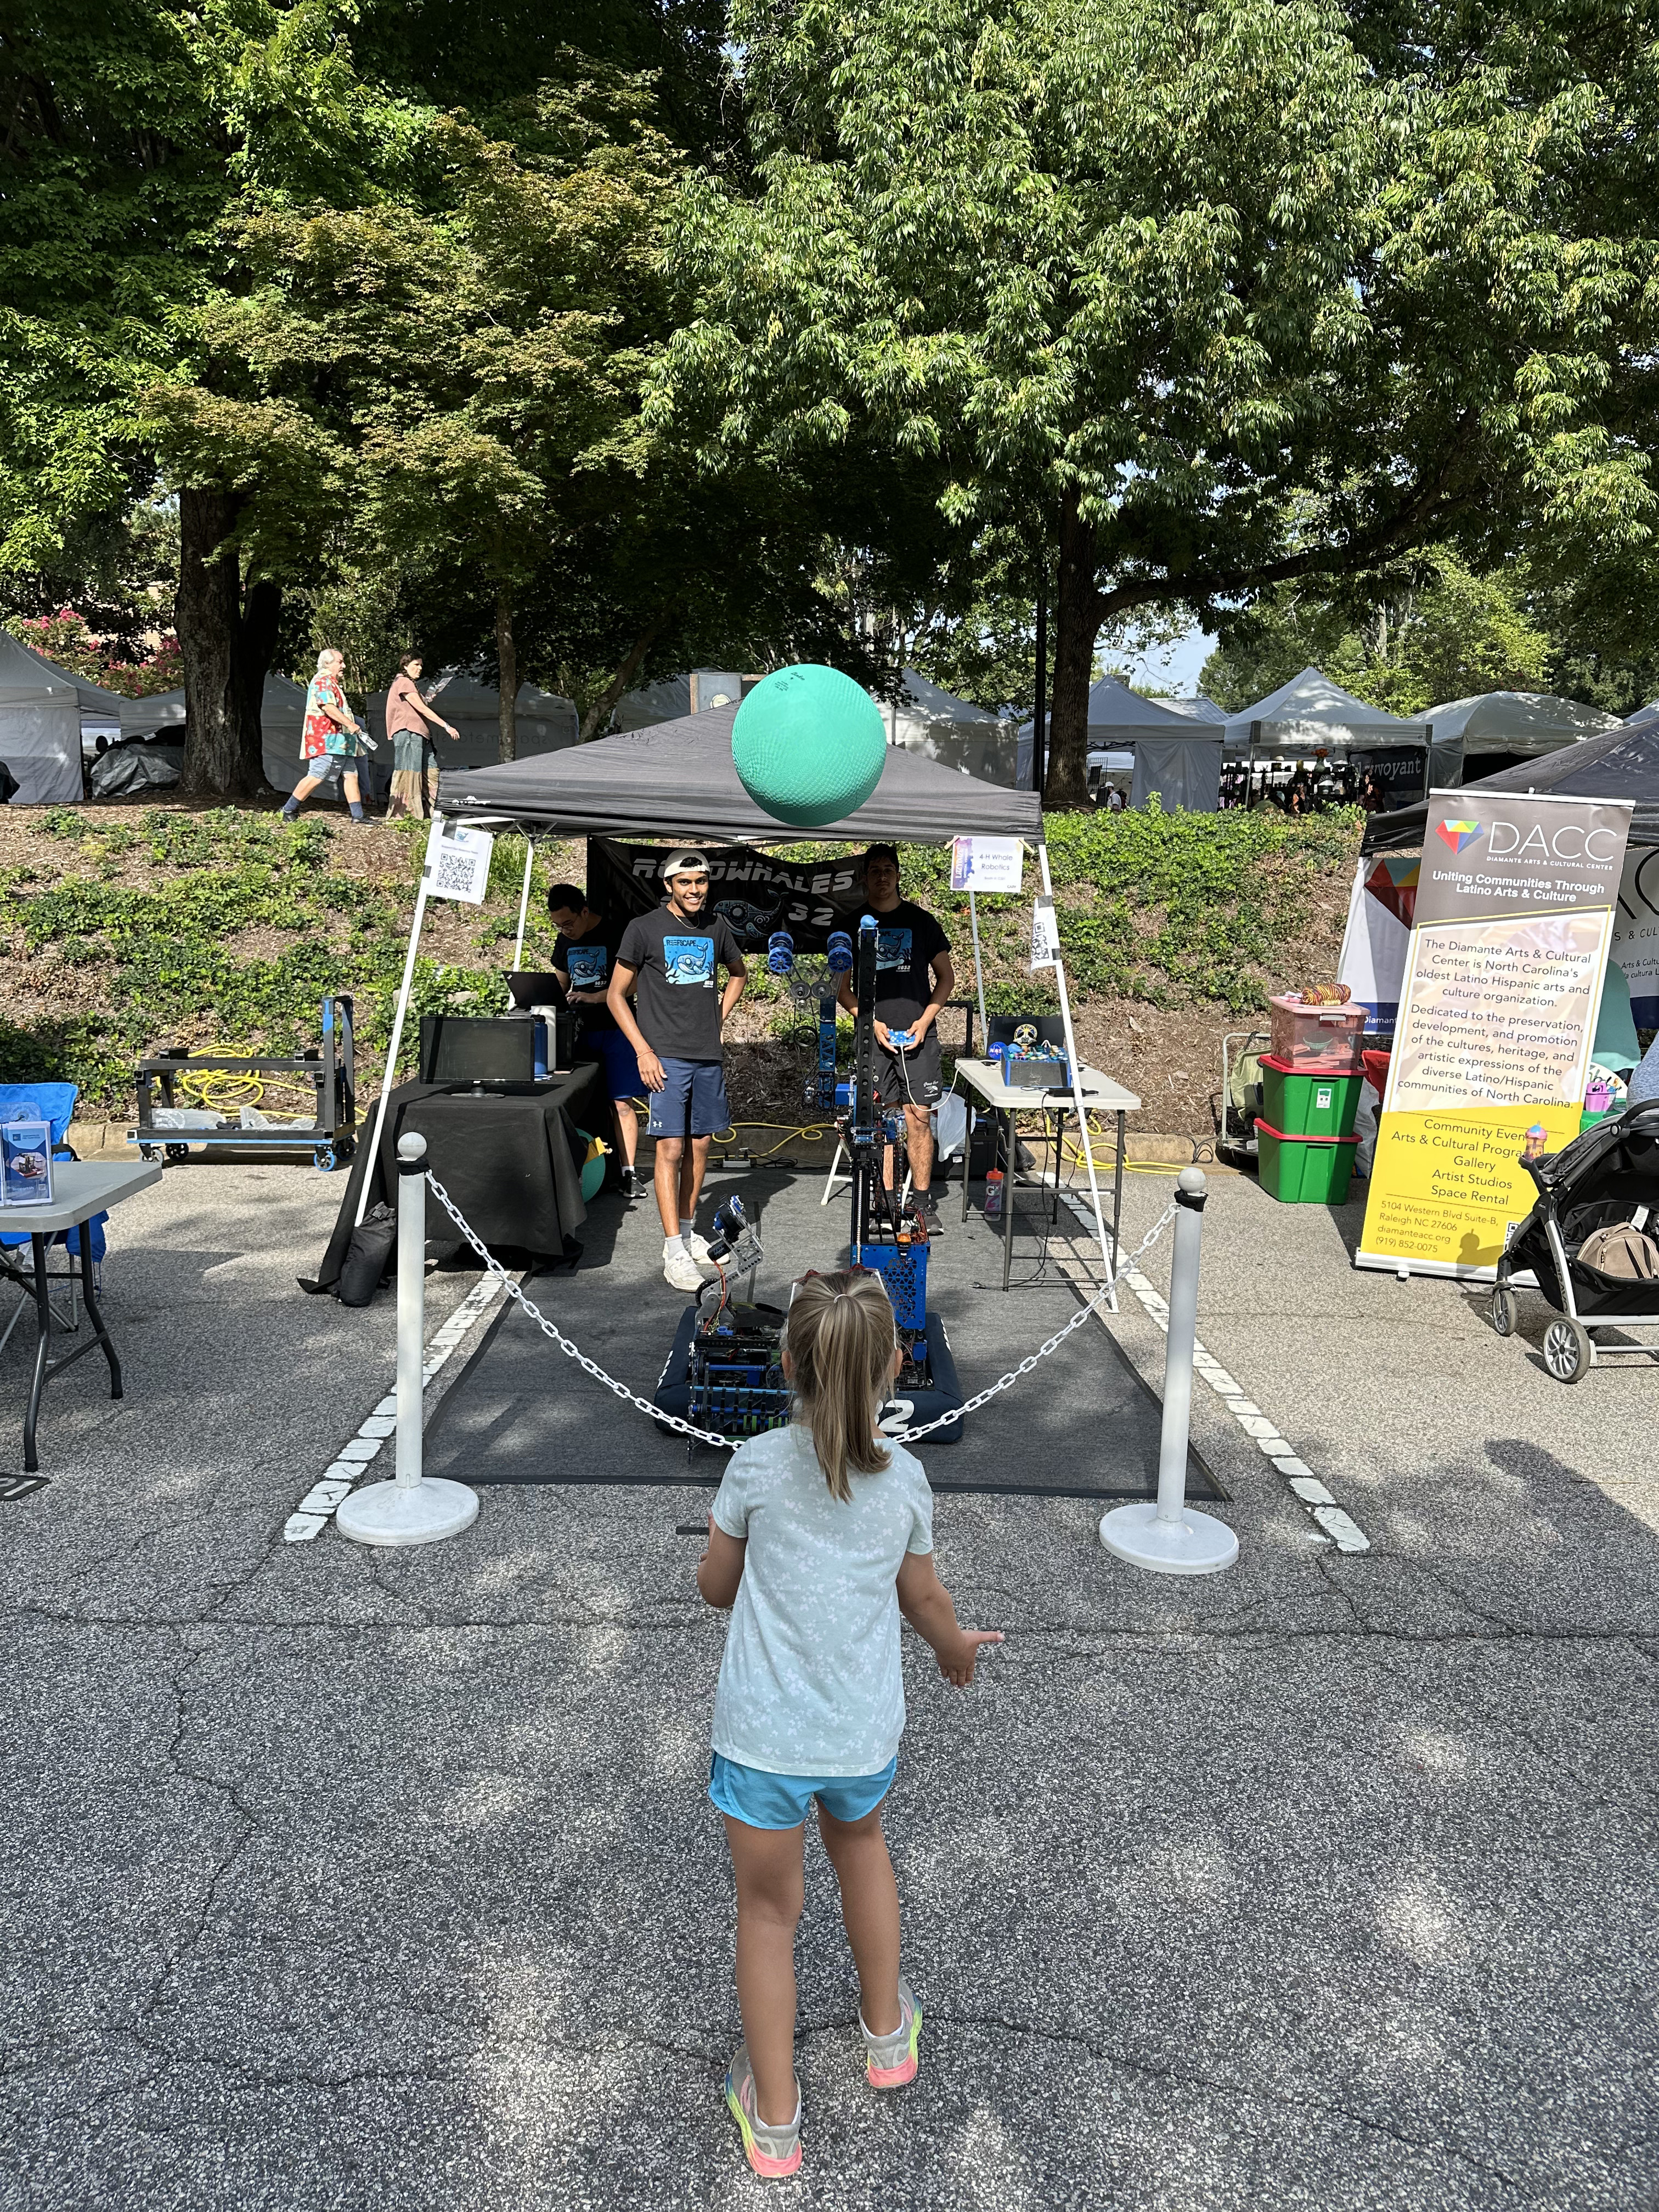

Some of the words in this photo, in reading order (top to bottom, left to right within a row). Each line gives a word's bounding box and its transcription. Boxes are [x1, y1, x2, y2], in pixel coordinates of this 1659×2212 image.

[1488, 821, 1617, 862] DACC
[632, 858, 855, 894] ROWHALES
[1432, 870, 1473, 884] Uniting
[1476, 874, 1551, 890] Communities
[1555, 880, 1605, 895] Through
[1457, 883, 1492, 895] Latino
[1494, 887, 1518, 898] Arts
[1521, 889, 1530, 899] &
[1534, 889, 1577, 902] Culture
[1628, 930, 1635, 940] &
[1640, 927, 1659, 938] CUL
[1425, 939, 1445, 949] The
[1449, 941, 1502, 955] Diamante
[1505, 947, 1529, 957] Arts
[1533, 949, 1542, 958] &
[1546, 950, 1591, 963] Cultural
[1432, 955, 1470, 967] Center
[1473, 959, 1481, 968] is
[1485, 960, 1518, 972] North
[1522, 964, 1578, 978] Carolina's
[1621, 961, 1634, 969] Arts
[1643, 958, 1659, 967] Cultu
[1630, 970, 1652, 979] cultura
[1417, 969, 1451, 980] oldest
[1454, 972, 1488, 984] Latino
[1492, 977, 1540, 990] Hispanic
[1543, 984, 1565, 992] arts
[1568, 985, 1590, 995] and
[1442, 988, 1480, 998] culture
[1484, 994, 1557, 1007] organization.
[1411, 1004, 1468, 1019] Dedicated
[1471, 1012, 1483, 1020] to
[1487, 1012, 1505, 1023] the
[1509, 1017, 1583, 1033] preservation,
[1413, 1019, 1488, 1038] development,
[1493, 1030, 1514, 1039] and
[1517, 1033, 1577, 1046] promotion
[1411, 1035, 1423, 1044] of
[1426, 1036, 1443, 1046] the
[1447, 1040, 1494, 1054] cultures,
[1498, 1044, 1548, 1060] heritage,
[1553, 1052, 1574, 1062] and
[1418, 1052, 1455, 1063] artistic
[1458, 1058, 1524, 1071] expressions
[1528, 1064, 1541, 1073] of
[1543, 1065, 1562, 1076] the
[1422, 1066, 1462, 1079] diverse
[1465, 1071, 1554, 1091] Latino/Hispanic
[1398, 1081, 1467, 1095] communities
[1471, 1088, 1483, 1097] of
[1487, 1089, 1519, 1102] North
[1523, 1094, 1573, 1109] Carolina.
[1424, 1119, 1492, 1139] Community
[1497, 1128, 1526, 1141] Even
[1391, 1131, 1415, 1143] Arts
[1419, 1135, 1429, 1144] &
[1432, 1136, 1479, 1152] Cultural
[1482, 1143, 1522, 1158] Progra
[1454, 1155, 1496, 1172] Gallery
[1432, 1169, 1464, 1182] Artist
[1468, 1174, 1513, 1189] Studios
[1431, 1185, 1467, 1199] Space
[1471, 1191, 1509, 1205] Rental
[1379, 1212, 1412, 1226] Raleigh
[1414, 1218, 1429, 1227] NC
[1431, 1220, 1457, 1231] 27606
[1381, 1200, 1401, 1210] 5104
[1404, 1204, 1440, 1216] Western
[1443, 1210, 1462, 1220] Blvd
[1464, 1213, 1498, 1226] Suite-B,
[1376, 1236, 1396, 1247] (919)
[1398, 1240, 1438, 1253] 852-0075
[1378, 1224, 1451, 1244] diamanteacc.org
